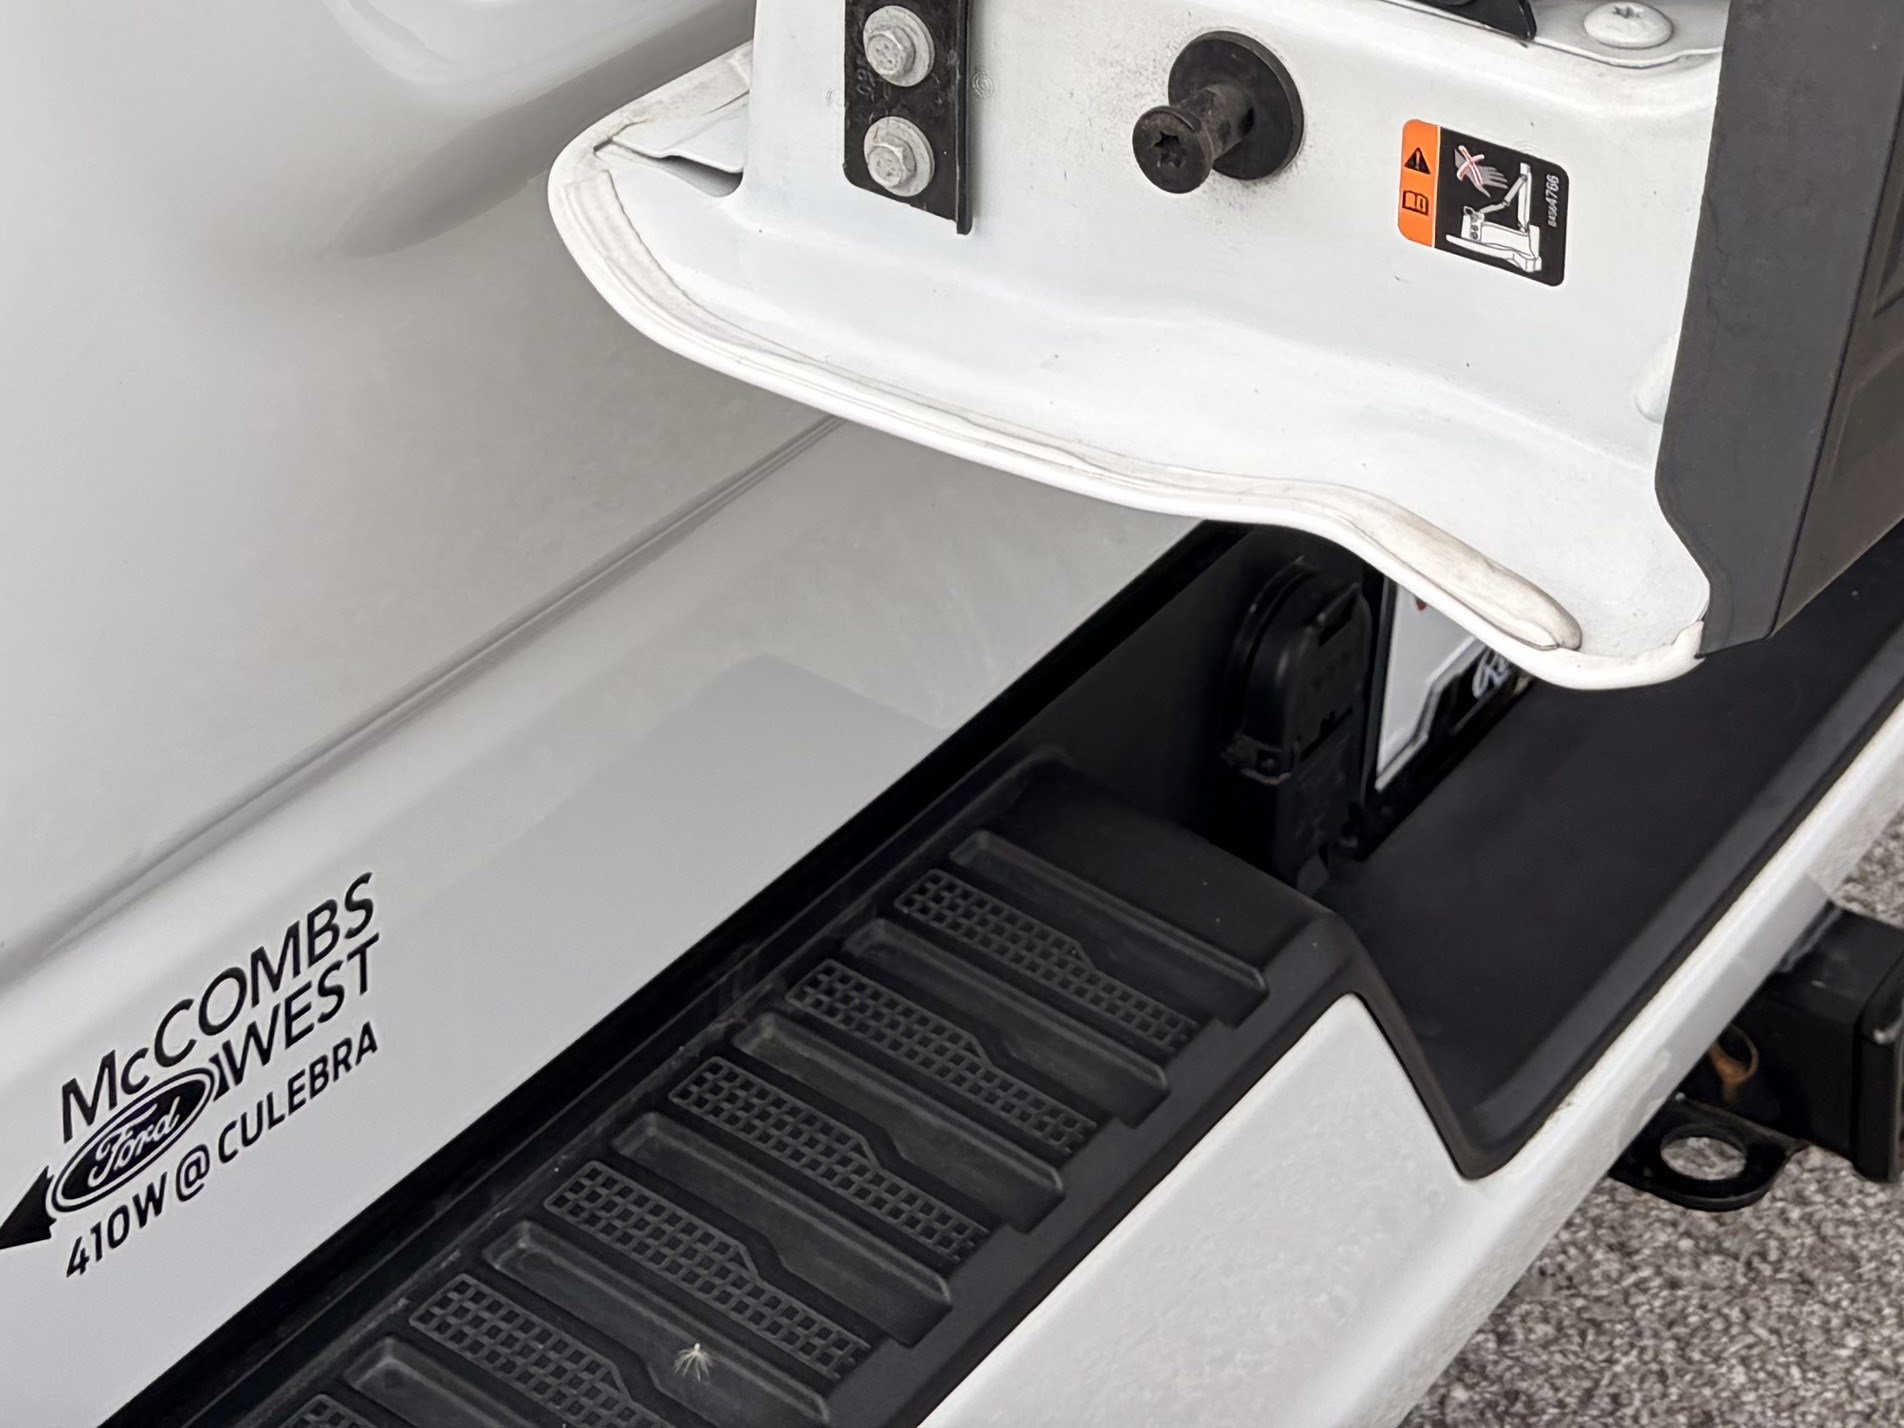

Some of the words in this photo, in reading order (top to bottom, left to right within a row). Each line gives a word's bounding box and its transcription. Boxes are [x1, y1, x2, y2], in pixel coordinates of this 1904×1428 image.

[221, 932, 380, 1087] WEST
[66, 1171, 169, 1278] 410W
[175, 1144, 211, 1202] @
[217, 1021, 380, 1165] CULEBRA
[88, 1097, 181, 1188] Ford
